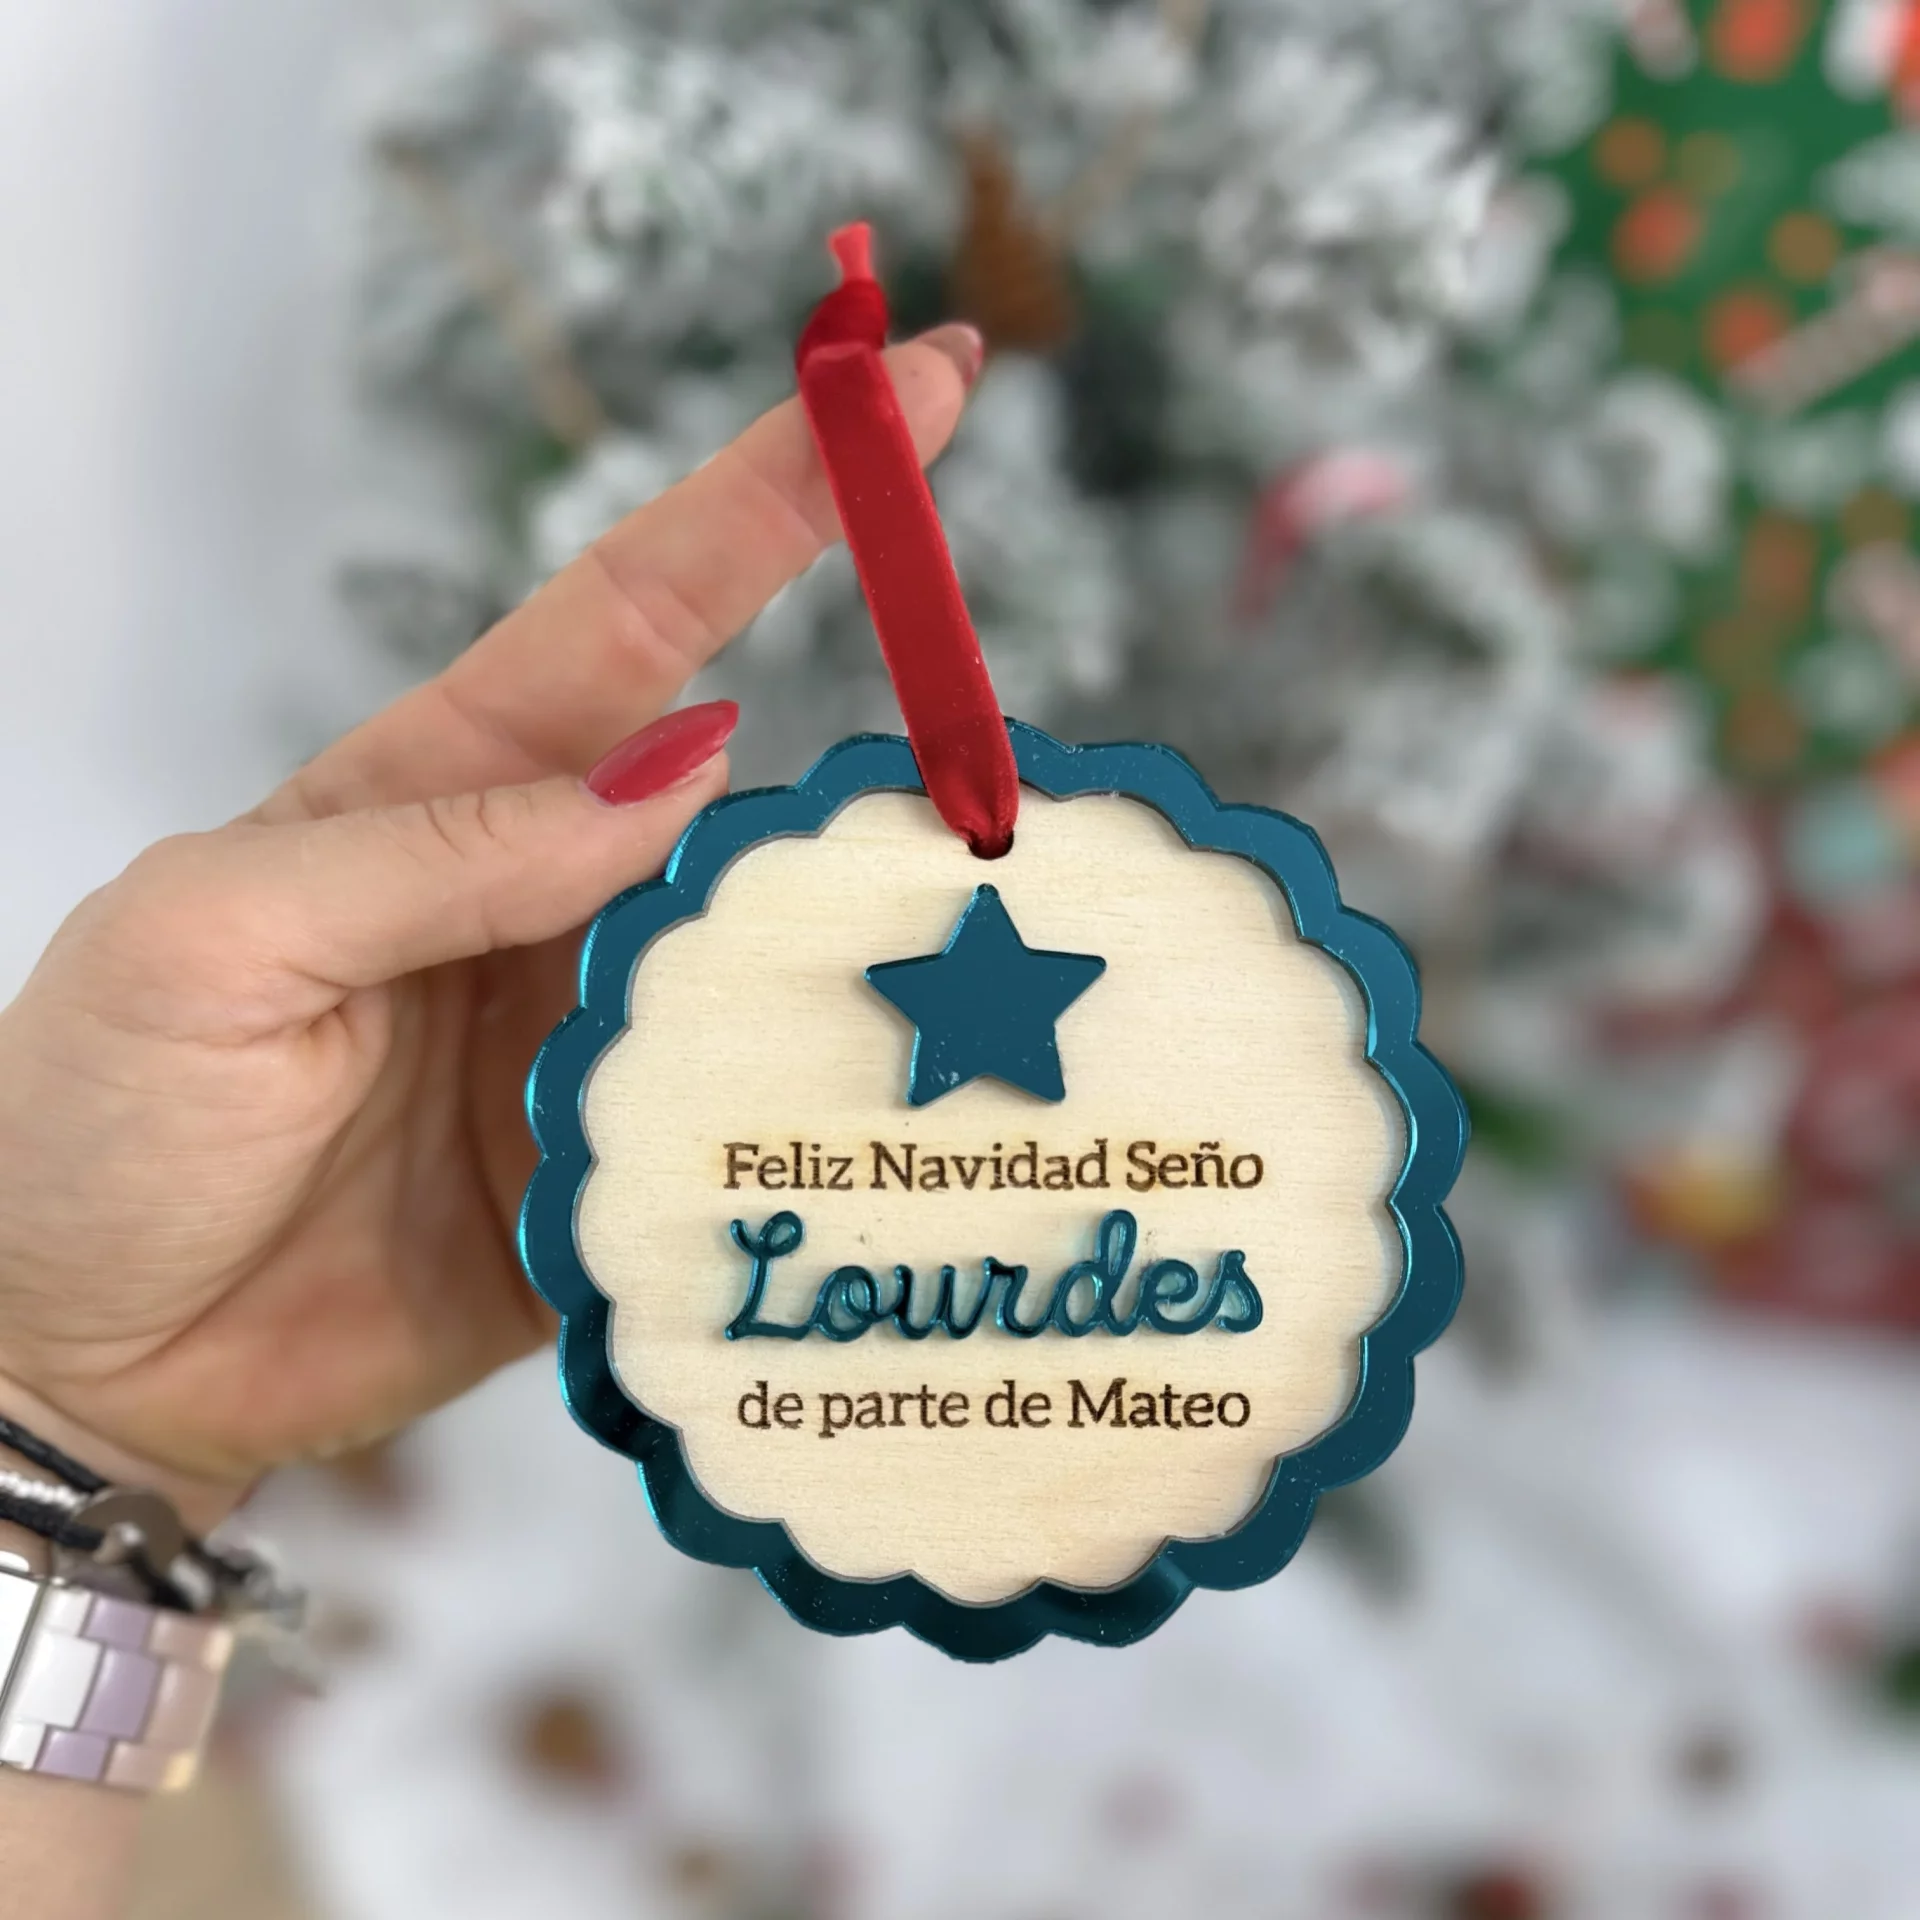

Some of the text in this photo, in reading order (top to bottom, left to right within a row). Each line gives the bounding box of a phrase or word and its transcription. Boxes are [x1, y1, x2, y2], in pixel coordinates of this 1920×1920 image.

[723, 1138, 1265, 1192] Feliz Navidad Seño
[724, 1208, 1264, 1343] Lourdes
[737, 1377, 1251, 1439] de parte de Mateo
